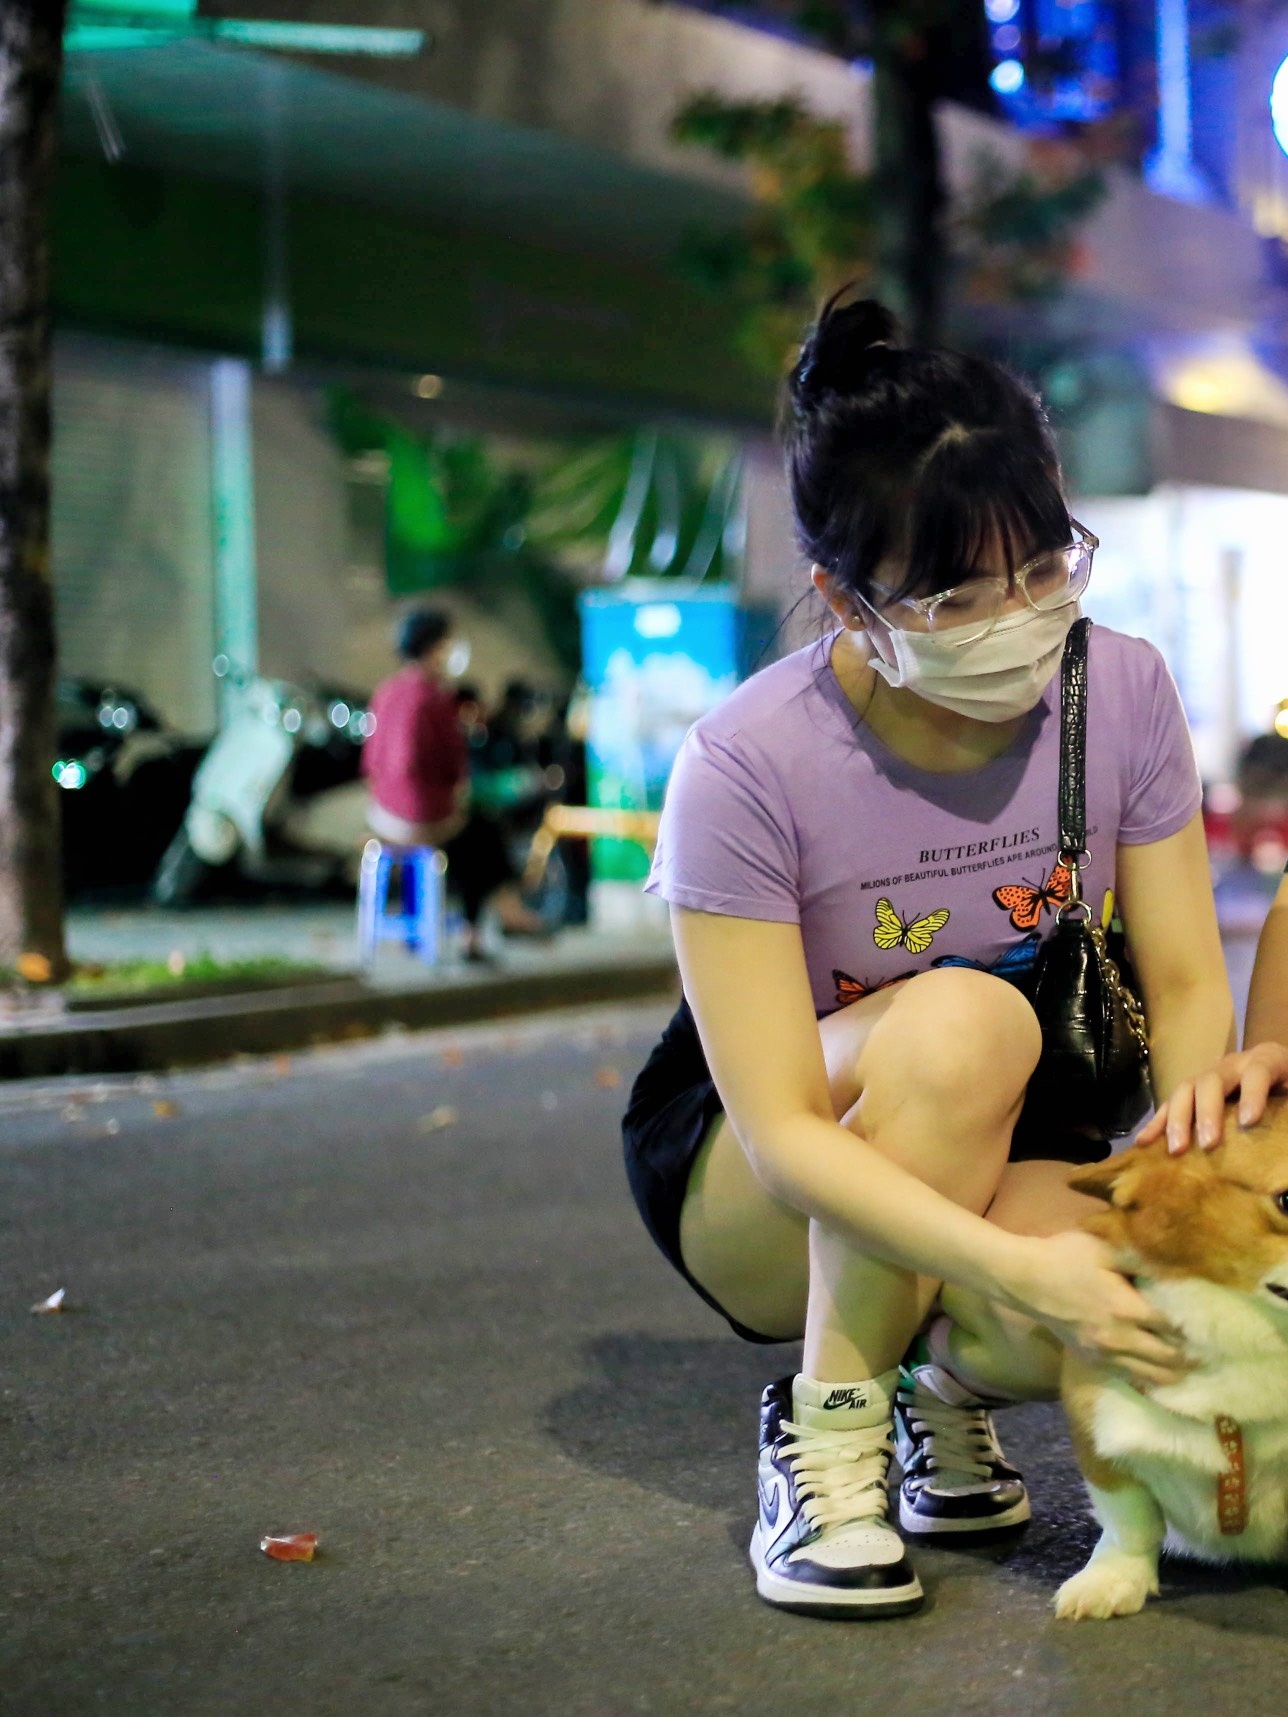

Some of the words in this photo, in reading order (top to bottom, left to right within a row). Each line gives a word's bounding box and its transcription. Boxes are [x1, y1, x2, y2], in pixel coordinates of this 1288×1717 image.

[919, 827, 1040, 863] BUTTERFLIES
[892, 875, 903, 886] OF
[904, 868, 949, 883] BEAUTIFUL
[950, 856, 1006, 876] BUTTERFLIES
[1025, 842, 1058, 859] AROUND
[828, 1388, 857, 1403] NIKE
[848, 1399, 868, 1410] AIR
